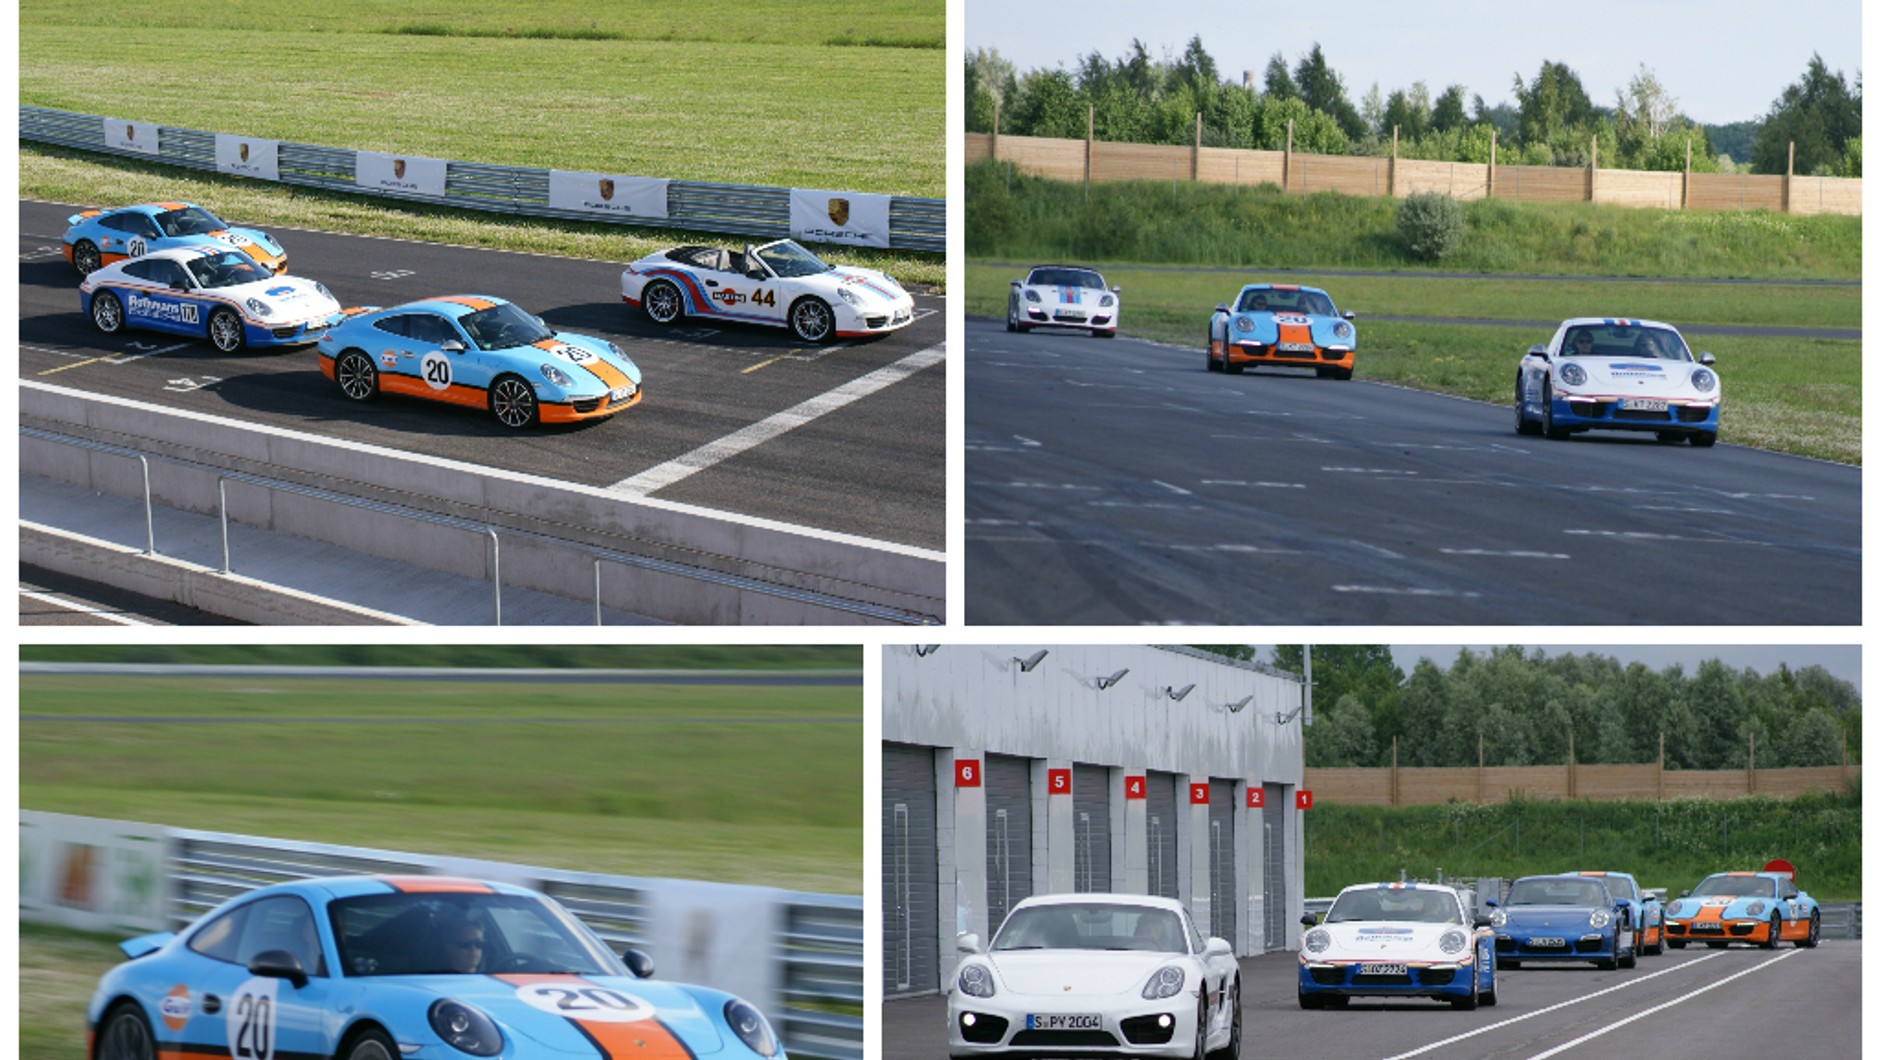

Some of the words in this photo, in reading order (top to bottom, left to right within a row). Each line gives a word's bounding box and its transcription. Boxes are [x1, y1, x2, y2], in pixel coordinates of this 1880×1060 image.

[751, 287, 776, 308] 44
[426, 358, 449, 385] 20
[963, 767, 973, 781] 6
[1055, 775, 1064, 788] 5
[1130, 781, 1140, 794] 4
[1196, 788, 1204, 799] 3
[1252, 793, 1260, 803] 2
[1301, 794, 1307, 804] 1
[535, 988, 640, 1011] 20
[236, 992, 270, 1060] 20
